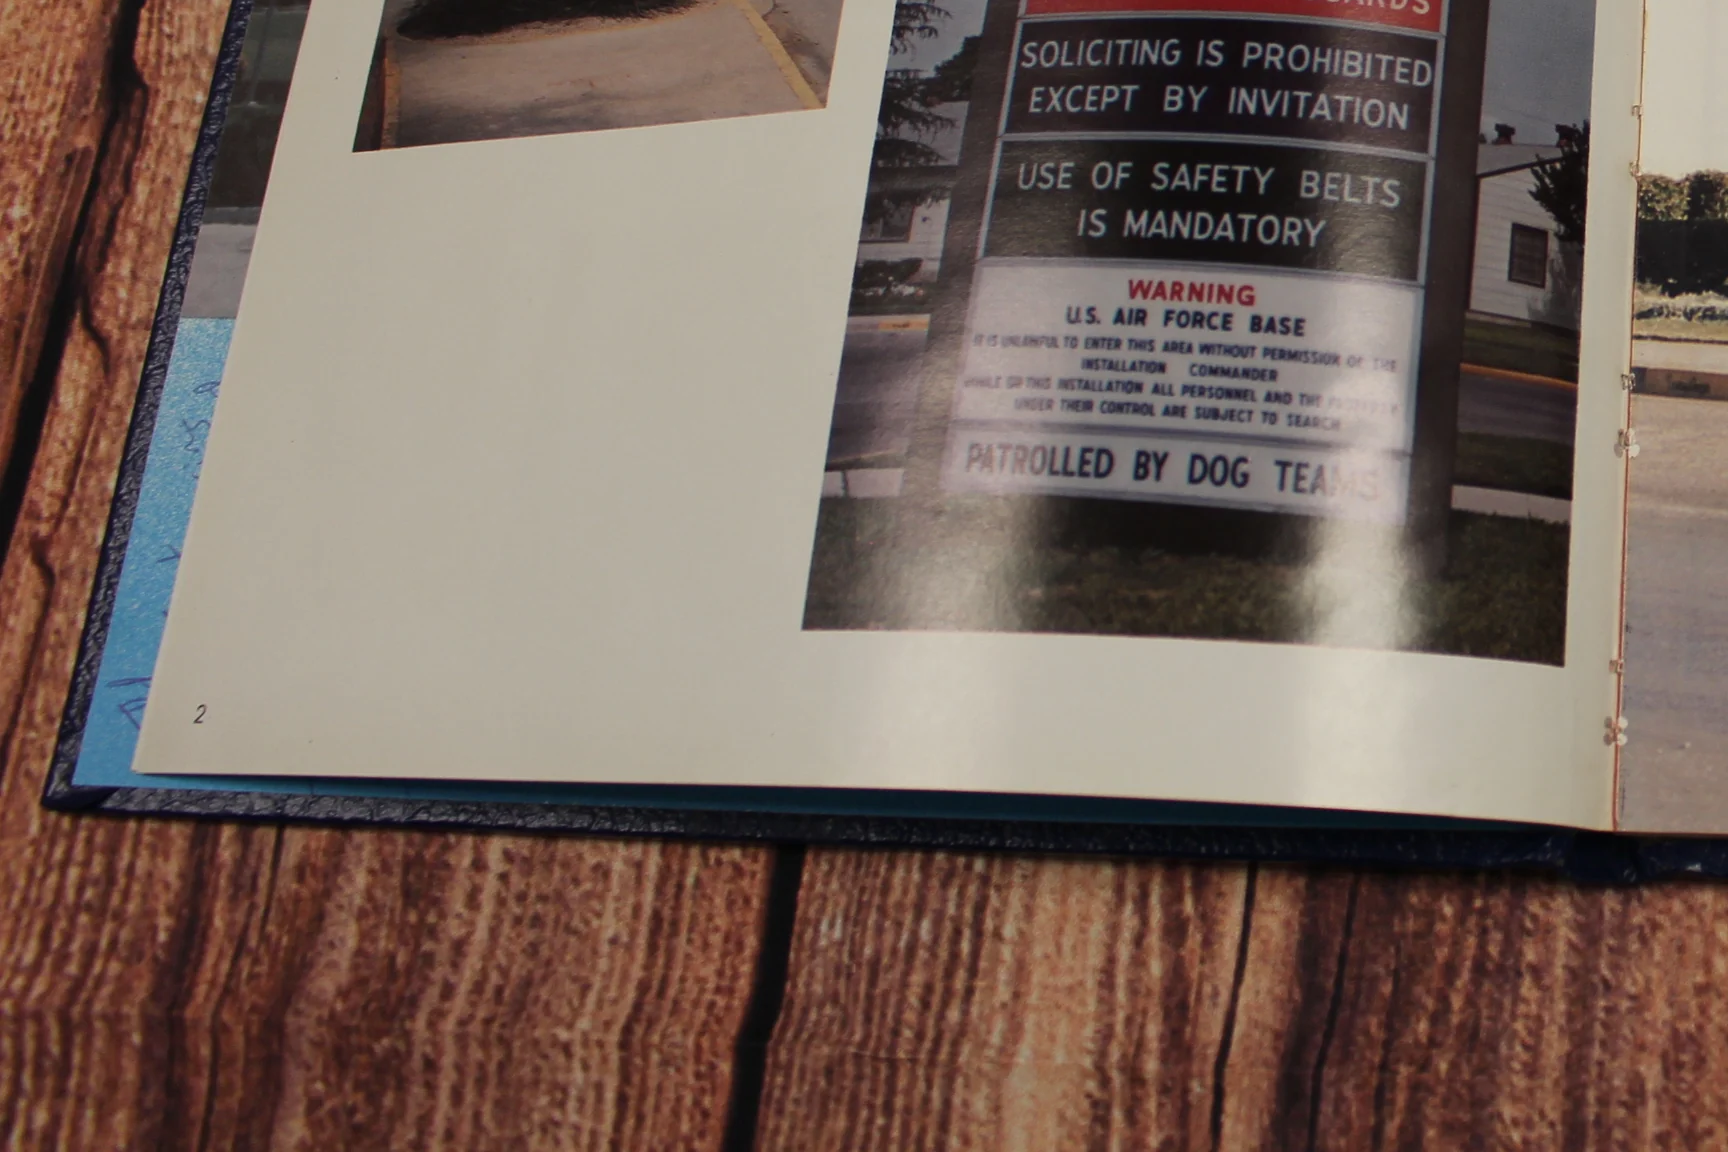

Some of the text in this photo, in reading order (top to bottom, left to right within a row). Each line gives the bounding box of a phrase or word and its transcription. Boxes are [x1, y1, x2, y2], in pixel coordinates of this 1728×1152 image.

[1021, 39, 1432, 88] SOLICITING IS PROHIBITED
[1028, 85, 1409, 130] EXCEPT BY INVITATION
[1017, 161, 1402, 208] USE OF SAFETY BELTS
[1077, 209, 1326, 247] IS MANDATORY
[1127, 279, 1256, 306] WARNING
[1066, 306, 1306, 337] U.S. AIR FORCE BASE
[1064, 336, 1079, 350] TO
[1084, 336, 1121, 351] ENTER
[1127, 338, 1155, 353] THIS
[1162, 340, 1194, 355] AREA
[1199, 342, 1257, 359] WITHOUT
[1262, 346, 1341, 367] PERMISSION
[1081, 358, 1279, 382] INSTALLATION COMMANDER
[1058, 377, 1143, 394] INSTALLATION
[1151, 382, 1174, 397] ALL
[1181, 384, 1256, 402] PERSONNEL
[1264, 391, 1293, 406] AND
[1060, 399, 1094, 414] THEIR
[1099, 400, 1156, 417] CONTROL
[1161, 404, 1187, 419] ARE
[1195, 406, 1254, 424] SUBJECT
[1262, 410, 1278, 426] TO
[965, 444, 1381, 503] PATROLLED BY DOG TEAMS
[193, 704, 207, 724] 2
